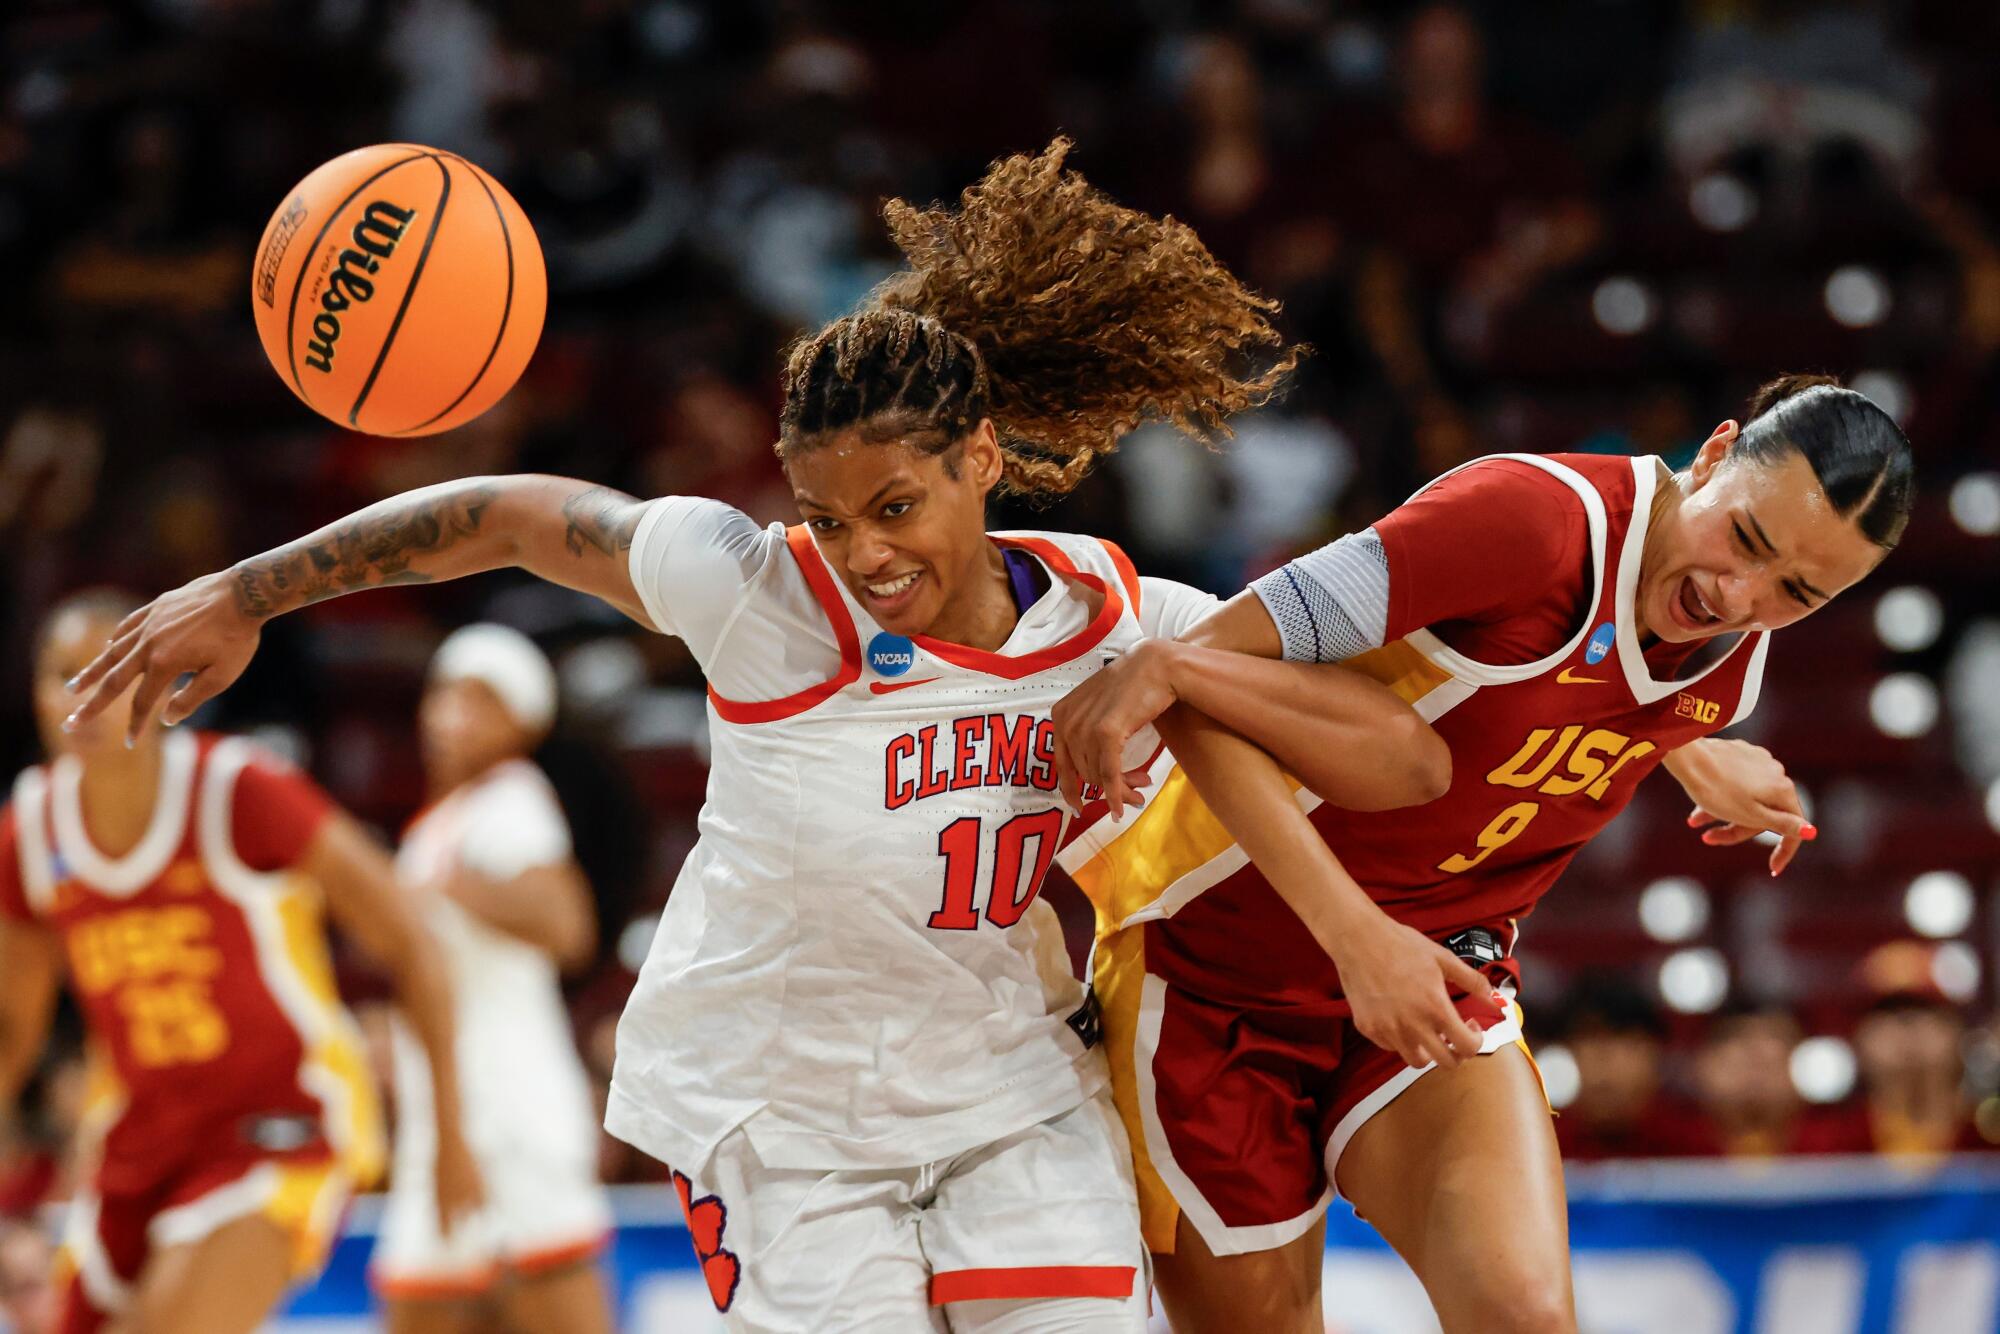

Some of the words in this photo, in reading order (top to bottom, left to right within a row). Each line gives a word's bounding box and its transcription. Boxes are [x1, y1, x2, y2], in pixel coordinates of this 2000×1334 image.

[305, 201, 416, 374] Wilson
[874, 653, 911, 665] NCAA
[885, 713, 1104, 810] CLEMS
[1486, 725, 1656, 800] USC
[927, 807, 1063, 930] 10
[1437, 801, 1539, 873] 9
